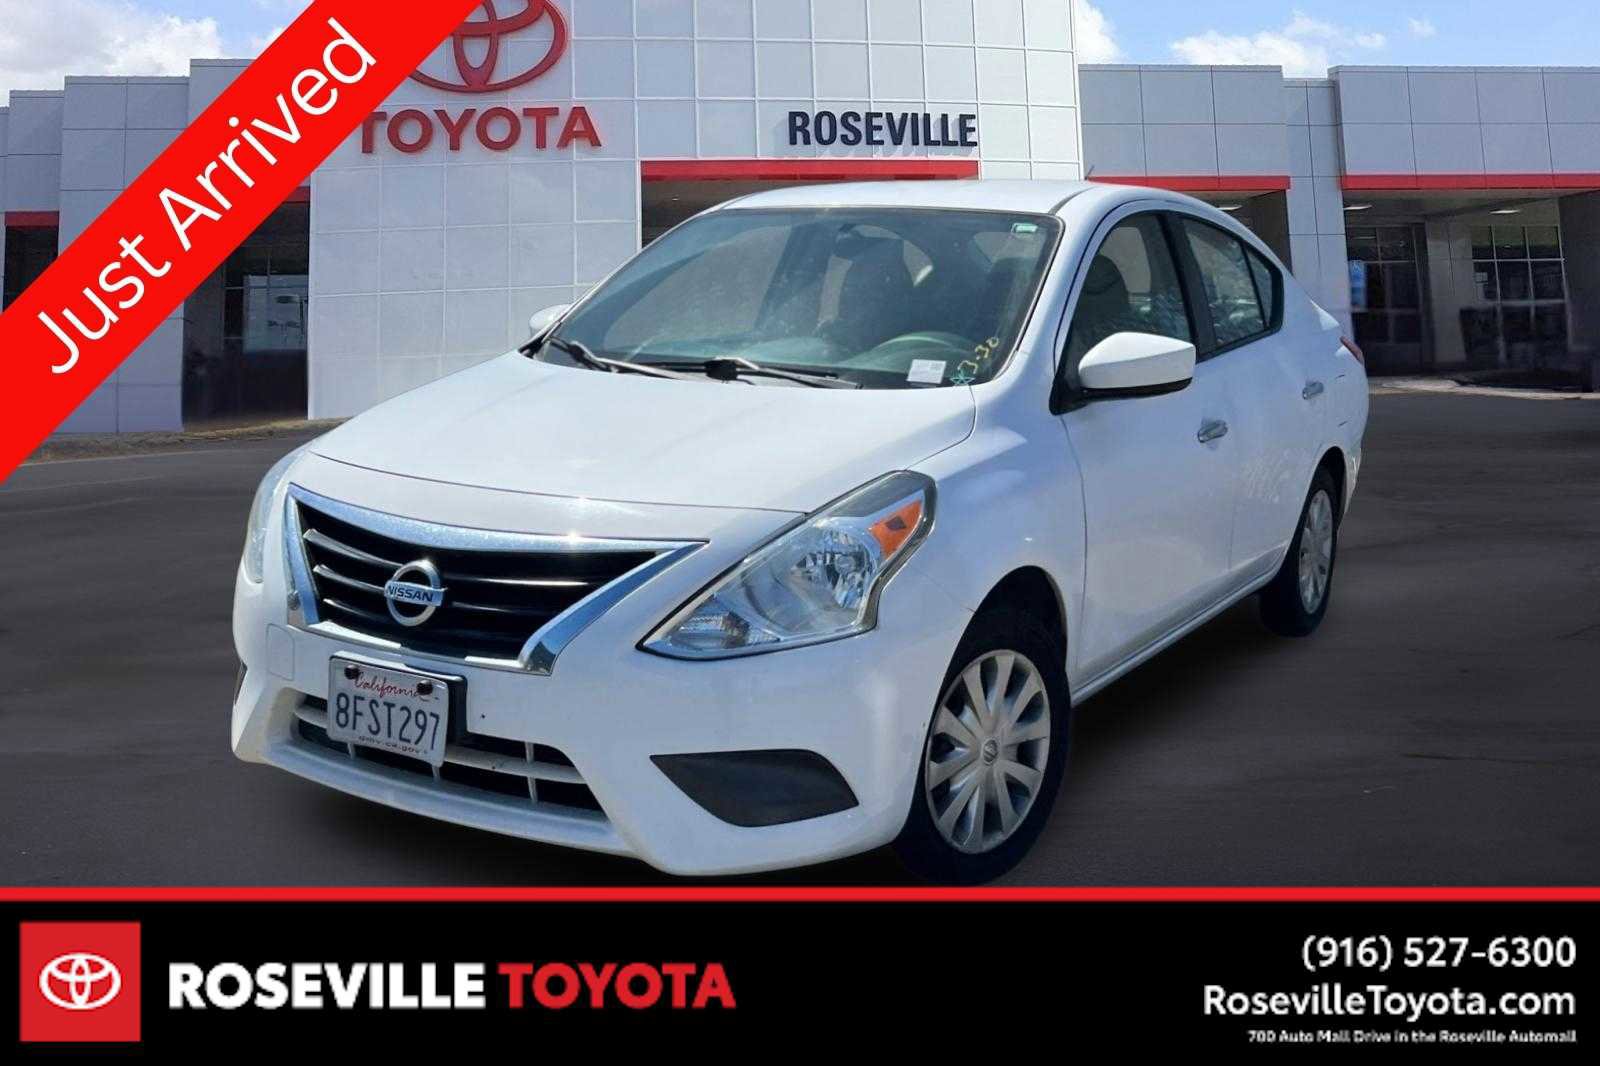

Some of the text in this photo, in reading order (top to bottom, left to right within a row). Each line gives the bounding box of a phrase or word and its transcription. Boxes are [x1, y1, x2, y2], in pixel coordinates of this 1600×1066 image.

[361, 106, 602, 153] TOYOTA
[788, 111, 978, 146] ROSEVILLE
[388, 584, 434, 602] NISSAN
[336, 692, 440, 751] 8FST297
